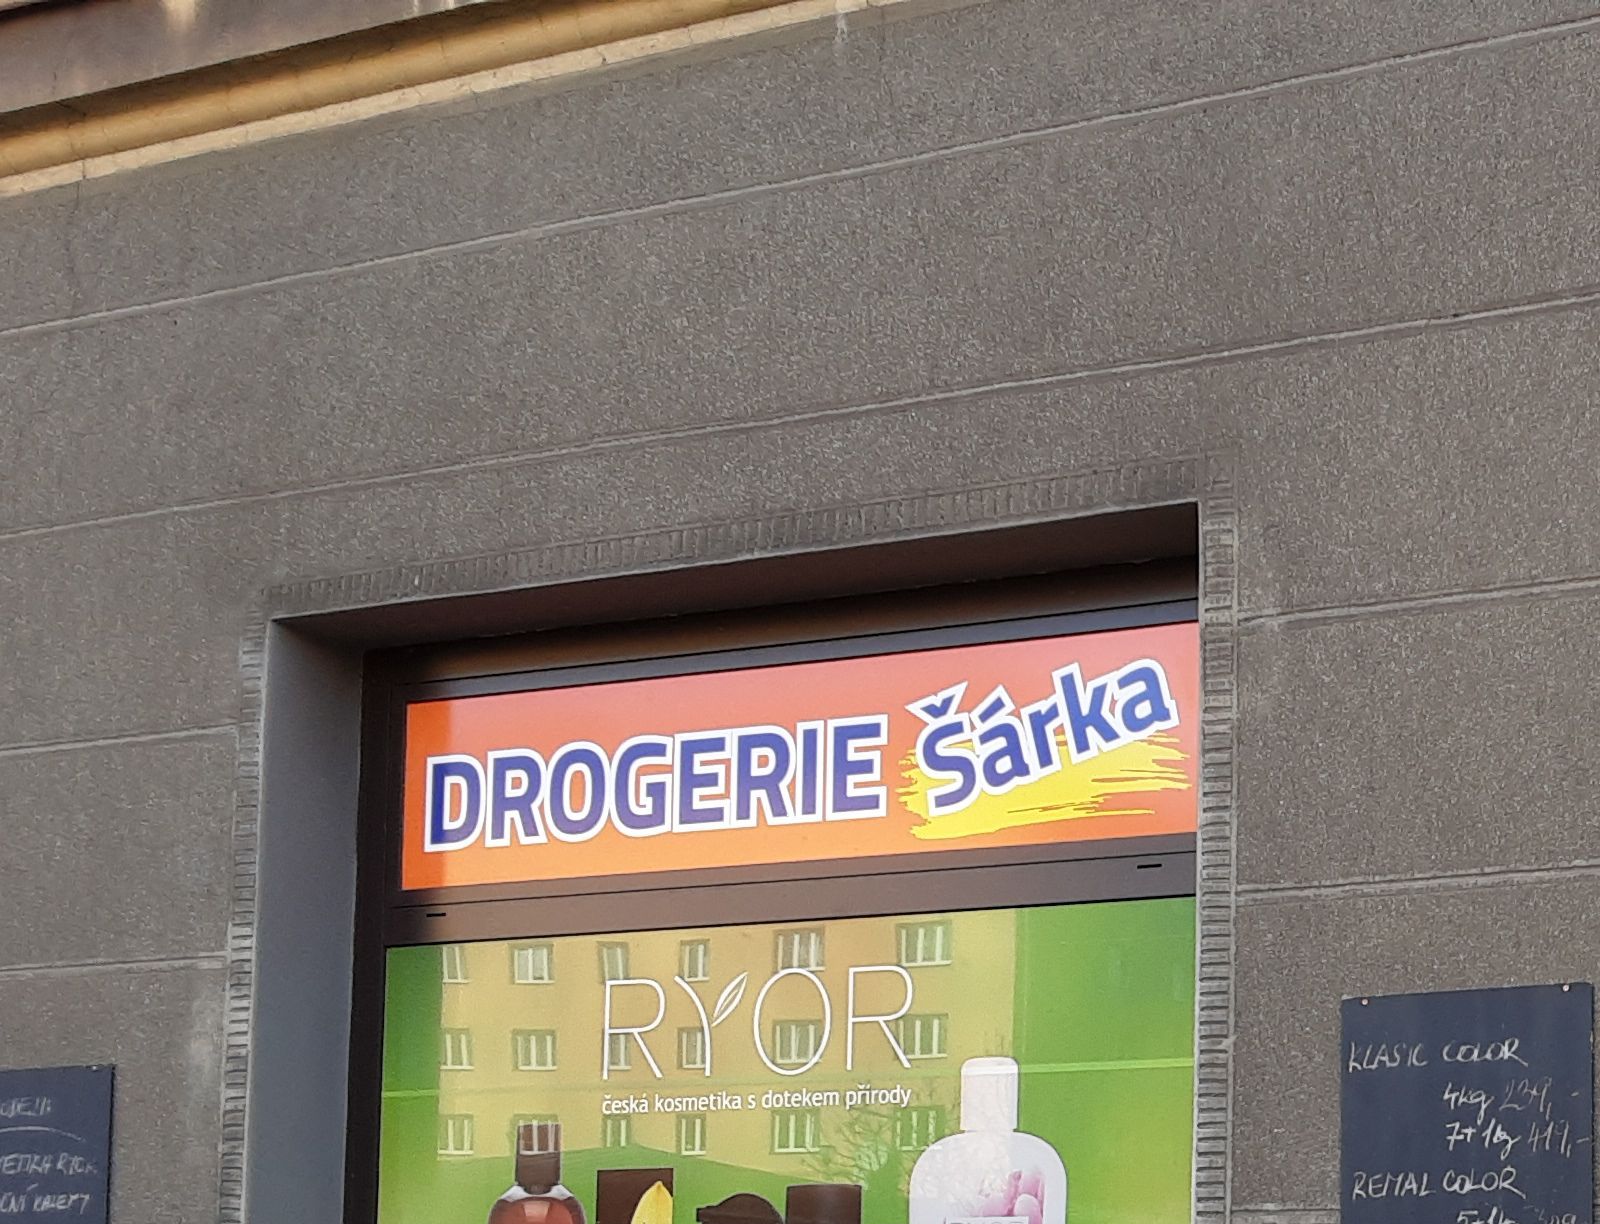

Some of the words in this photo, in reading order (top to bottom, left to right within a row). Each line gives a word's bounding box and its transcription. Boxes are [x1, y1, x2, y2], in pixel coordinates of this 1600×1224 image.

[424, 715, 888, 853] DROGERIE
[907, 658, 1181, 817] Šárka
[602, 965, 913, 1080] RYOR
[1443, 1037, 1528, 1067] COLOR
[602, 1094, 649, 1114] česká
[654, 1090, 742, 1112] kosmetika
[747, 1095, 757, 1109] s
[761, 1088, 839, 1109] dotekem
[846, 1082, 912, 1110] přírody
[1353, 1171, 1437, 1200] REMAL
[1443, 1165, 1526, 1199] COLOR
